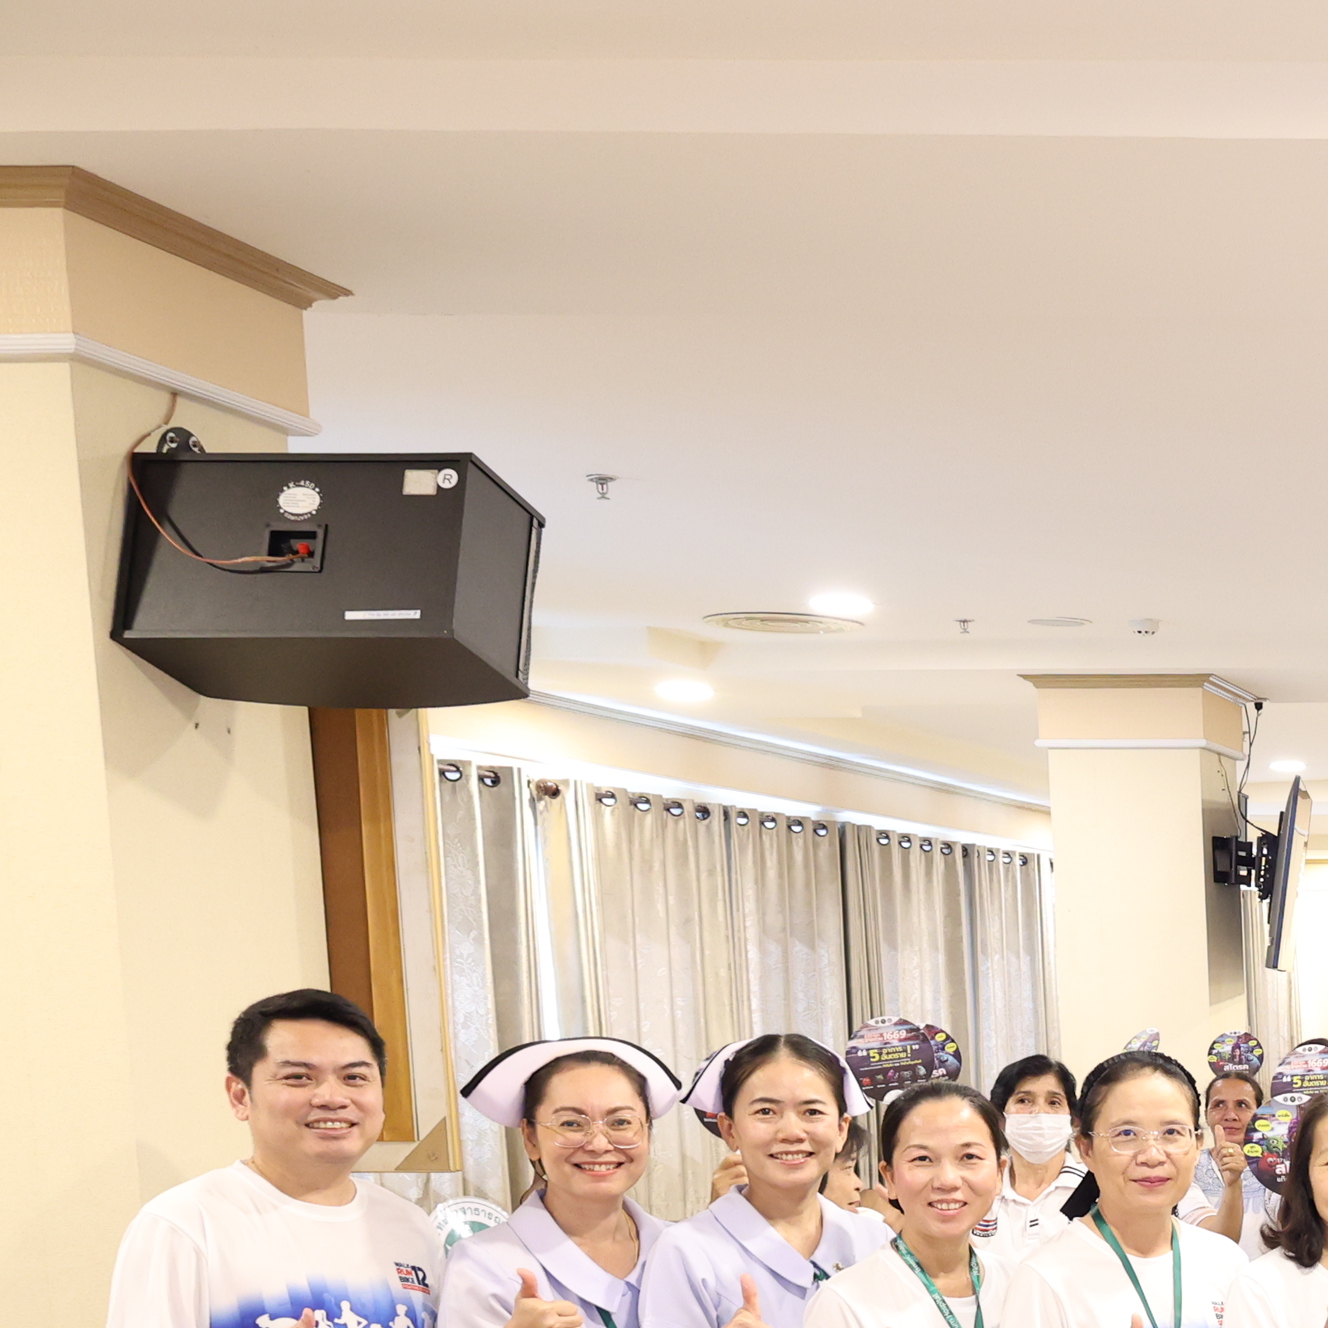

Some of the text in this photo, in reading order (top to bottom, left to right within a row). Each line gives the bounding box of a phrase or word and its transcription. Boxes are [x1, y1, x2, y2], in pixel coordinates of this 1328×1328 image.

[443, 473, 453, 485] R
[882, 1030, 907, 1041] 1669
[869, 1049, 880, 1062] 5
[1308, 1058, 1328, 1068] 1669
[1293, 1076, 1301, 1087] 5
[410, 1265, 429, 1288] 12
